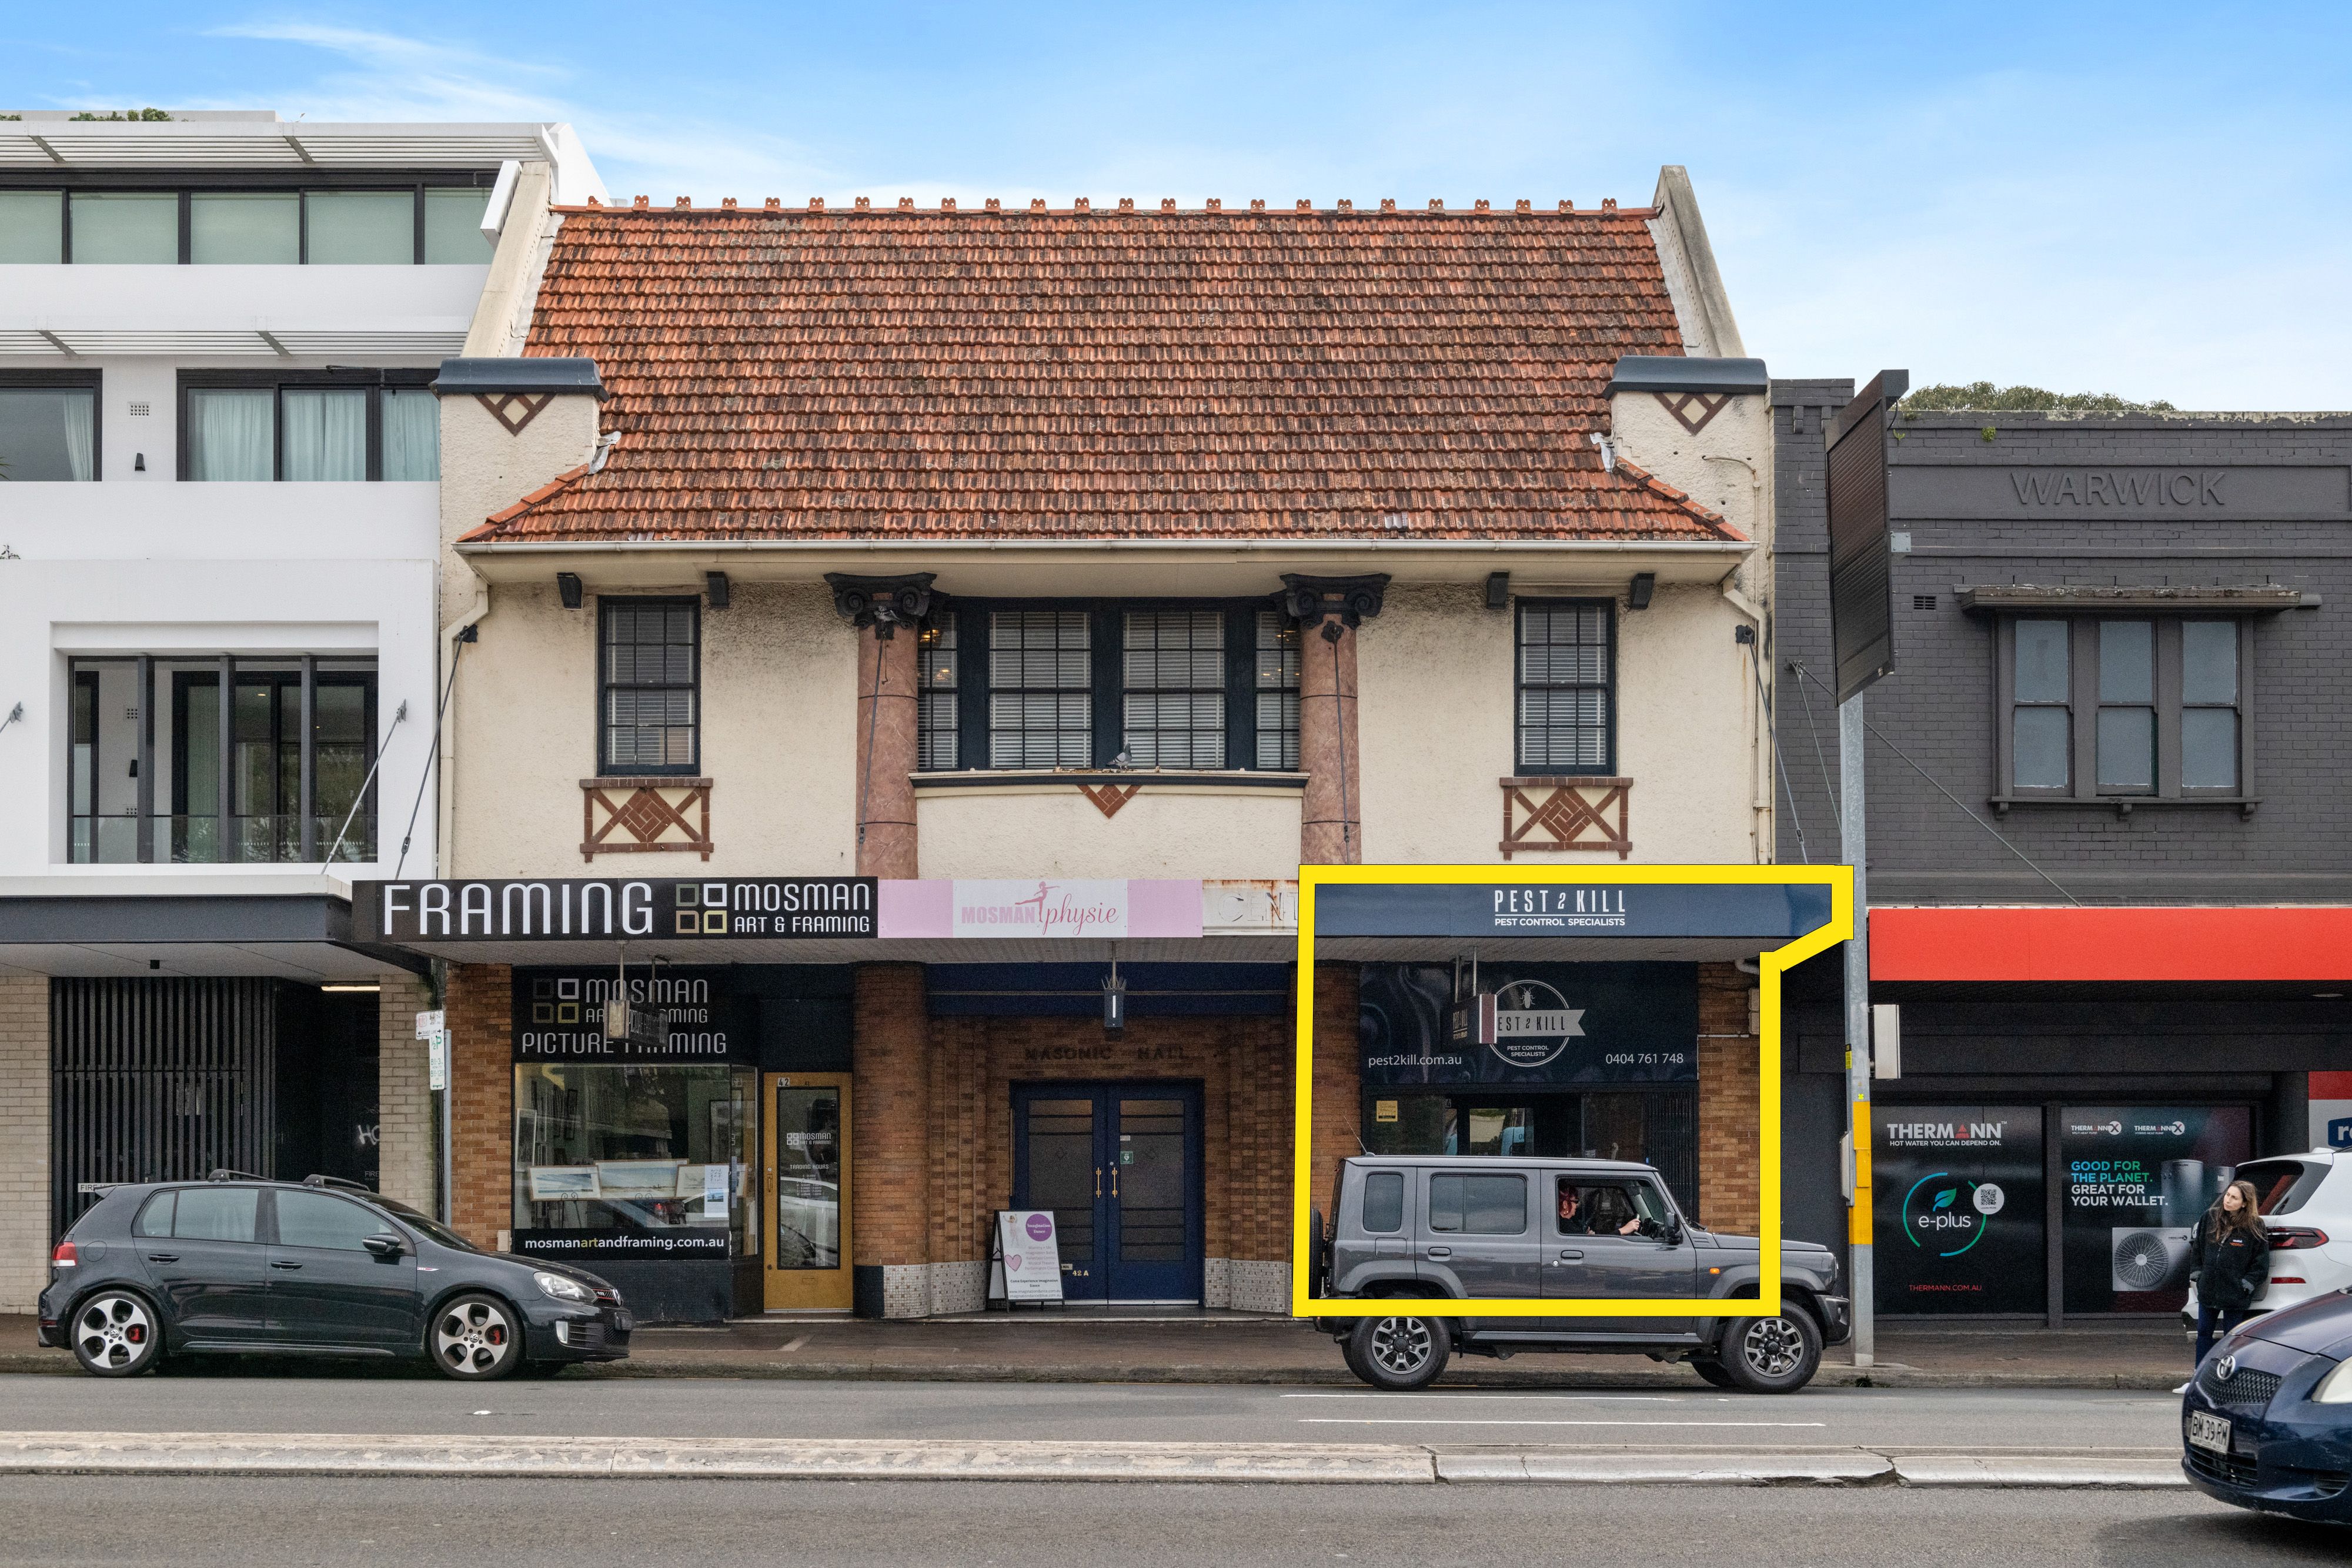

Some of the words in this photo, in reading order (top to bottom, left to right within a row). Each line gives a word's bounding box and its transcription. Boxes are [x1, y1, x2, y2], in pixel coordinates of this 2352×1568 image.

[2011, 472, 2225, 504] WARWICK
[734, 883, 869, 911] MOSMAN
[1495, 890, 1548, 912] PEST
[1558, 892, 1566, 909] 2
[1576, 890, 1625, 912] KILL
[385, 882, 653, 935] FRAMING
[961, 907, 1035, 924] MOSMAN
[1042, 894, 1119, 935] physie
[734, 917, 767, 932] ART
[774, 917, 785, 932] &
[793, 916, 870, 932] FRAMING
[1568, 918, 1625, 926] SPECIALISTS
[586, 979, 708, 1004] MOSMAN
[586, 1008, 604, 1023] AR
[660, 1008, 708, 1023] MING
[1498, 1017, 1521, 1031] EST
[1525, 1018, 1531, 1029] 2
[1536, 1016, 1565, 1031] KILL
[522, 1033, 614, 1053] PICTURE
[1368, 1054, 1462, 1068] pest2kill.com.au
[1606, 1054, 1635, 1064] 0404
[1638, 1054, 1657, 1064] 761
[1662, 1054, 1683, 1063] 748
[1887, 1123, 2002, 1139] THERMANN
[2072, 1161, 2110, 1171] GOOD
[2114, 1161, 2140, 1171] FOR
[2071, 1173, 2096, 1182] THE
[2100, 1172, 2153, 1182] PLANET.
[2072, 1185, 2115, 1194] GREAT
[2119, 1185, 2144, 1194] FOR
[2071, 1196, 2108, 1206] YOUR
[2111, 1196, 2168, 1205] WALLET.
[1918, 1212, 1971, 1231] e-plus
[525, 1236, 724, 1250] mosmanartandframing.com.au
